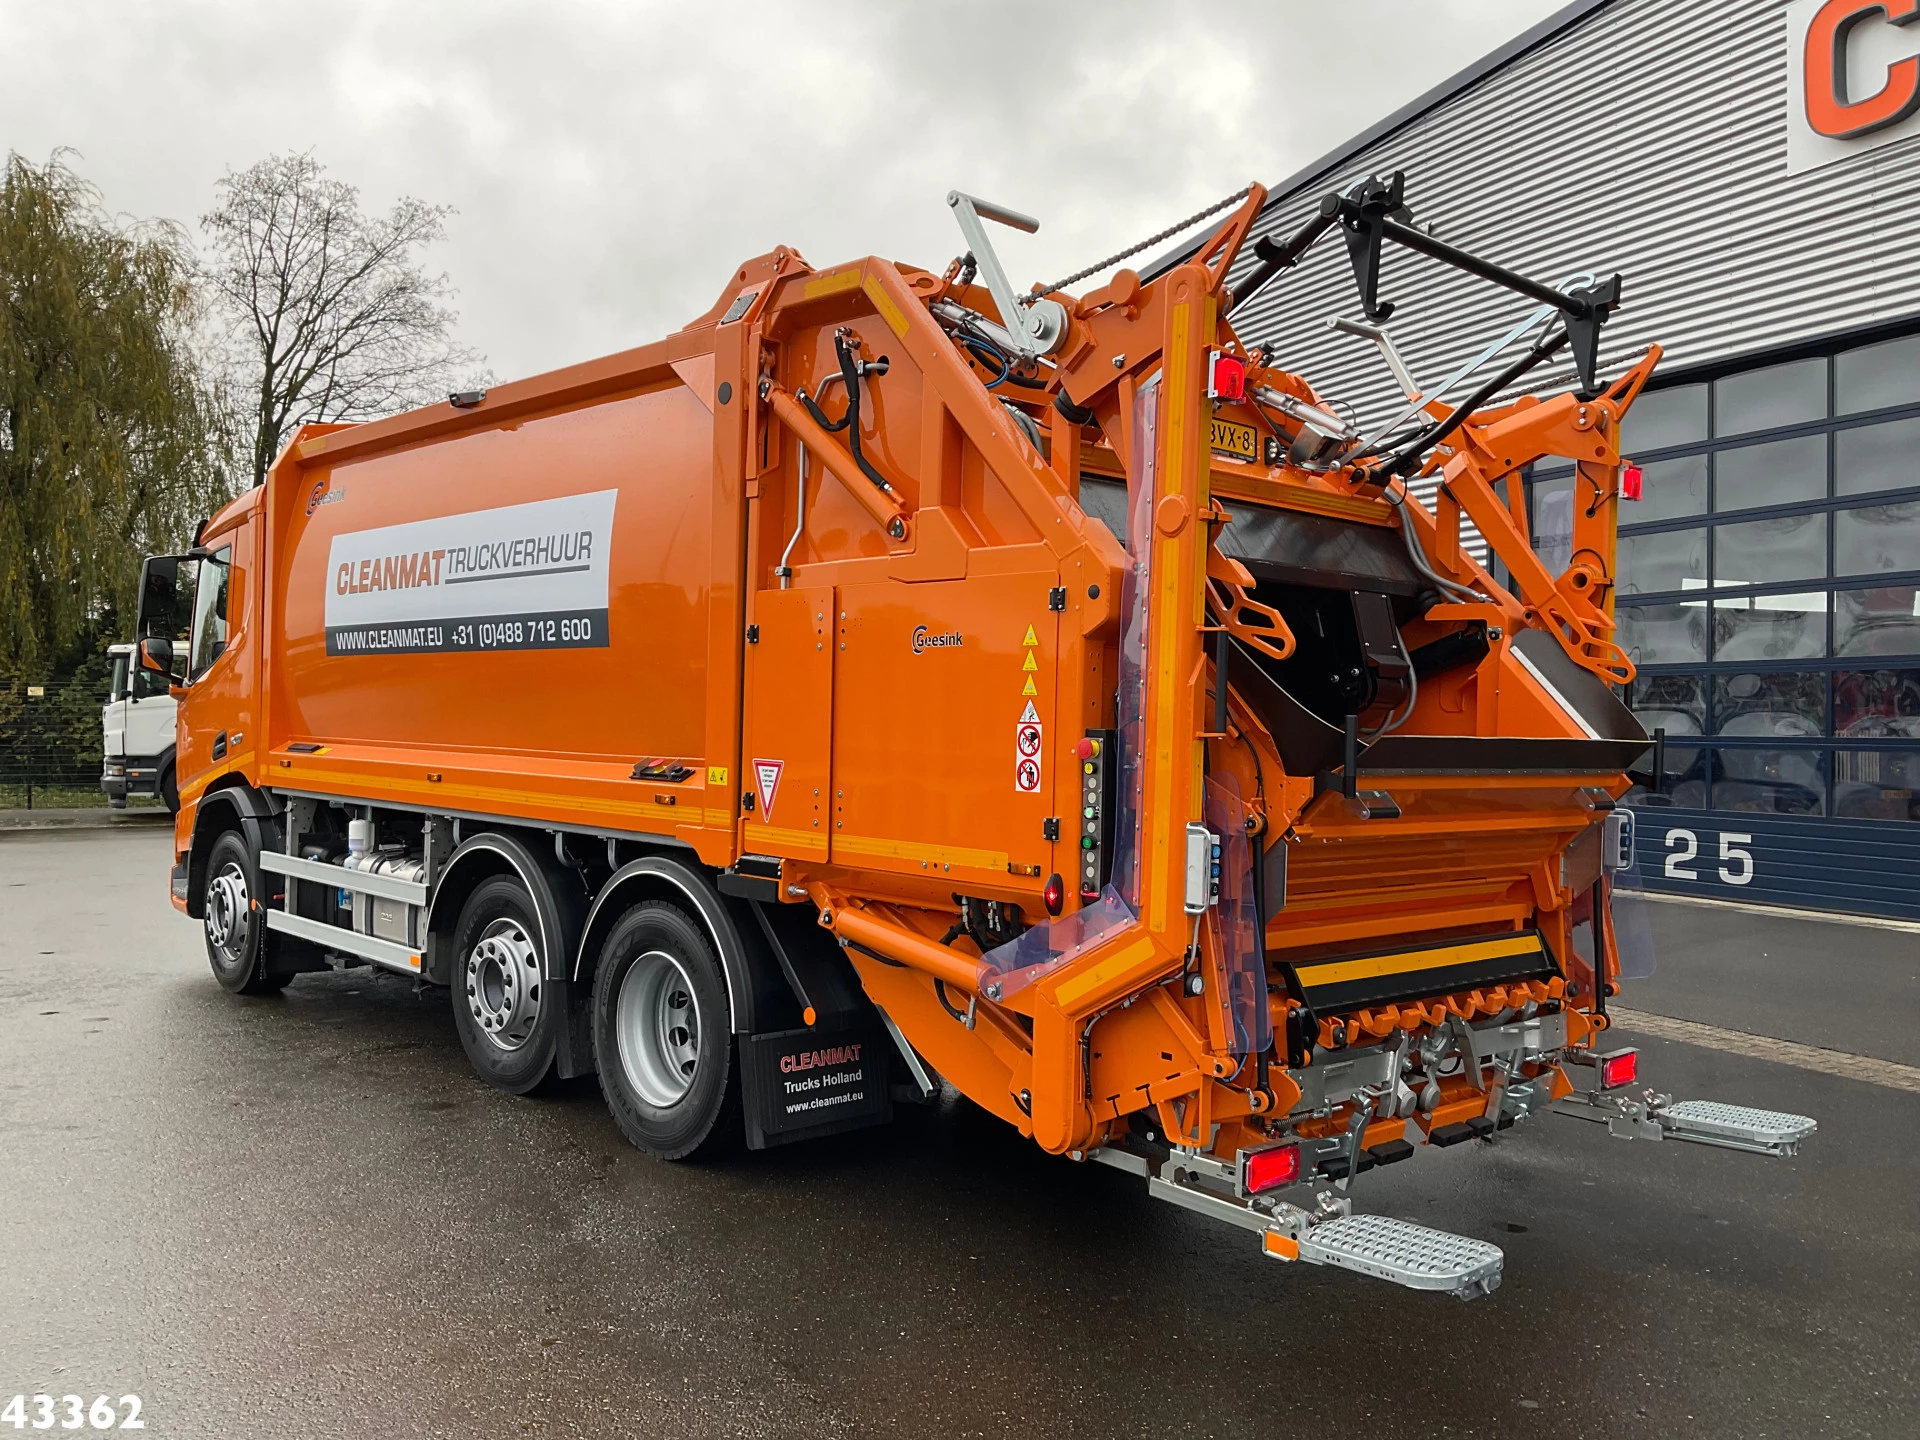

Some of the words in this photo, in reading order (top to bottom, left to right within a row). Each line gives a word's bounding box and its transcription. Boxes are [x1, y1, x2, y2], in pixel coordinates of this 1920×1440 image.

[309, 485, 347, 509] Geesink
[336, 549, 446, 596] CLEANMAT
[447, 531, 593, 574] TRUCKVERHUUR
[335, 626, 443, 650] WWW.CLEANMAT.EU
[451, 625, 474, 645] +31
[479, 622, 523, 647] (0)488
[528, 620, 556, 642] 712
[561, 618, 591, 641] 600
[914, 630, 963, 648] Geesink
[780, 1044, 861, 1074] CLEANMAT
[784, 1078, 820, 1094] Trucks
[823, 1069, 862, 1087] Holland
[786, 1091, 863, 1113] www.cleanmat.eu
